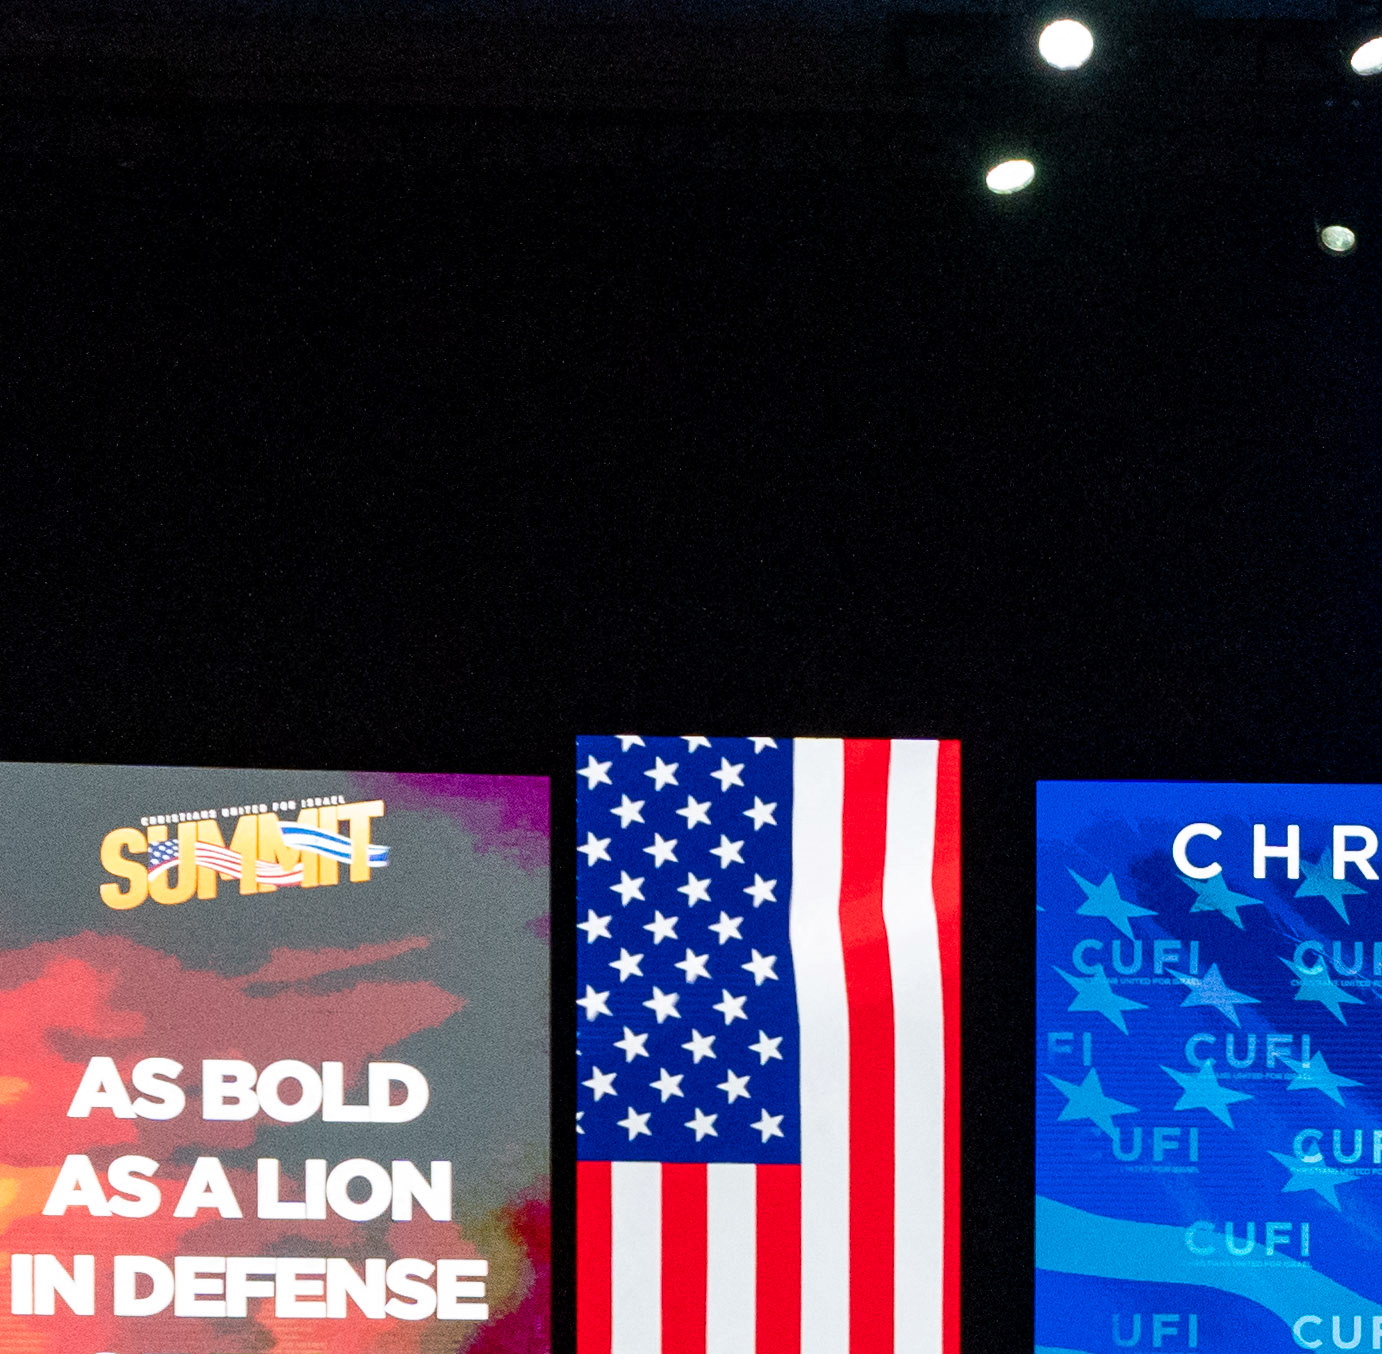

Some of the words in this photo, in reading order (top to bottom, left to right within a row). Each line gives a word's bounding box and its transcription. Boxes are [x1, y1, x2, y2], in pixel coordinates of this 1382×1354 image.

[141, 808, 217, 827] CHRISTIANS
[222, 803, 268, 817] UNITED
[272, 799, 296, 812] FOR
[300, 795, 345, 808] ISRAEL
[100, 800, 385, 911] SUMMIT
[1185, 1033, 1310, 1068] CUFI
[67, 1056, 185, 1120] AS
[202, 1058, 429, 1123] BOLD
[42, 1154, 161, 1218] AS
[173, 1156, 243, 1218] A
[257, 1158, 452, 1222] LION
[1185, 1221, 1310, 1256] CUFI
[11, 1253, 95, 1316] IN
[113, 1255, 489, 1320] DEFENSE
